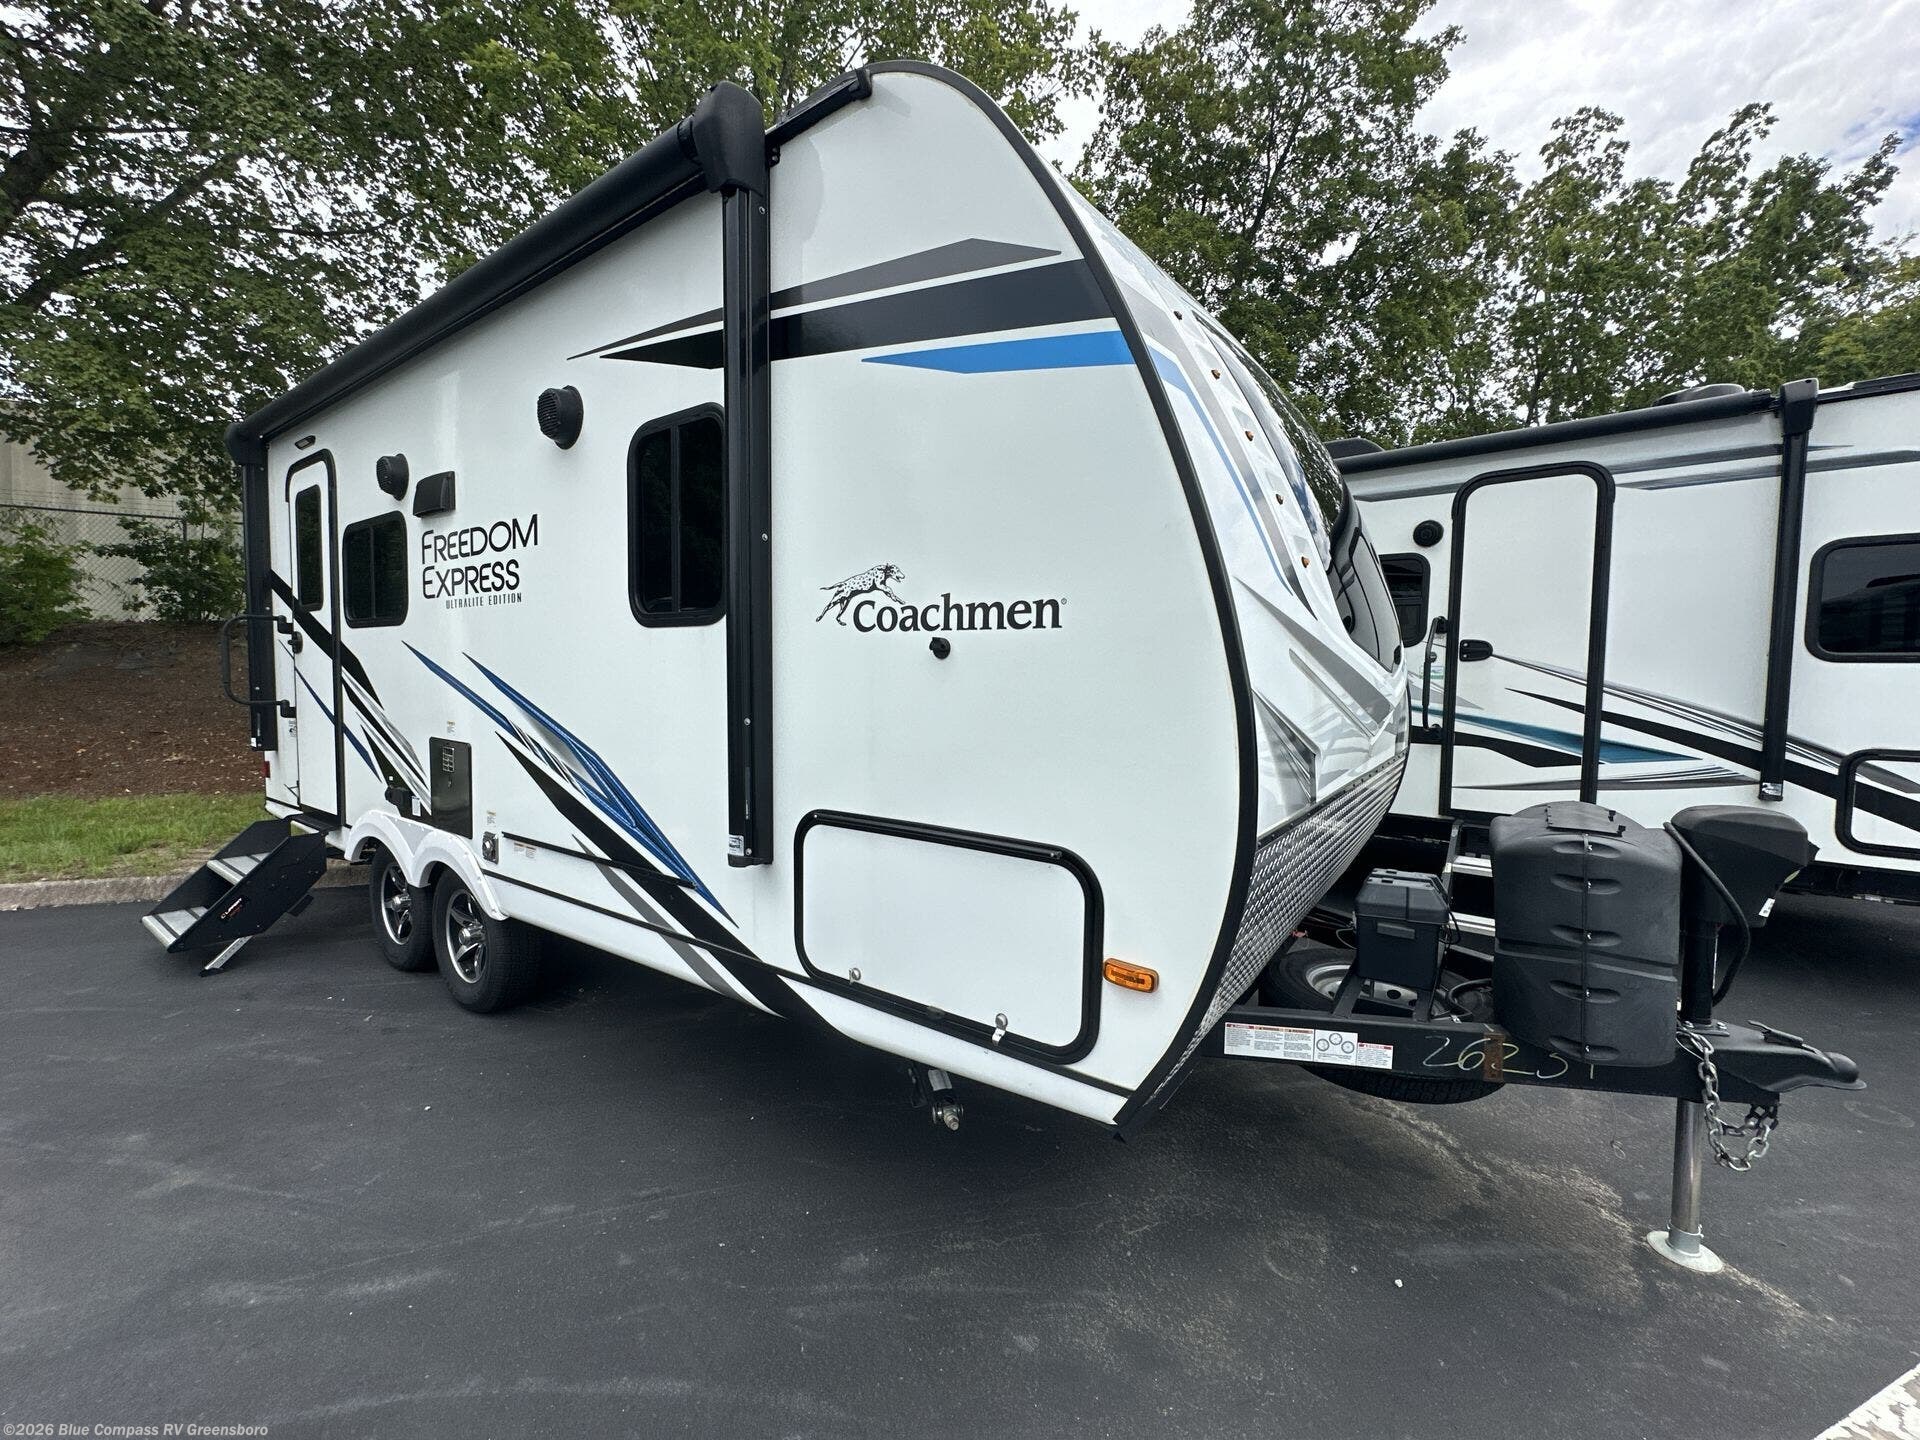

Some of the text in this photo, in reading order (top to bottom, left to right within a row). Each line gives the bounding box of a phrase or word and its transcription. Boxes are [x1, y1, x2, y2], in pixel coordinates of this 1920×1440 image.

[421, 514, 538, 564] FREEDOM
[422, 558, 520, 599] EXPRESS
[445, 592, 522, 610] ULTRALITE EDITION
